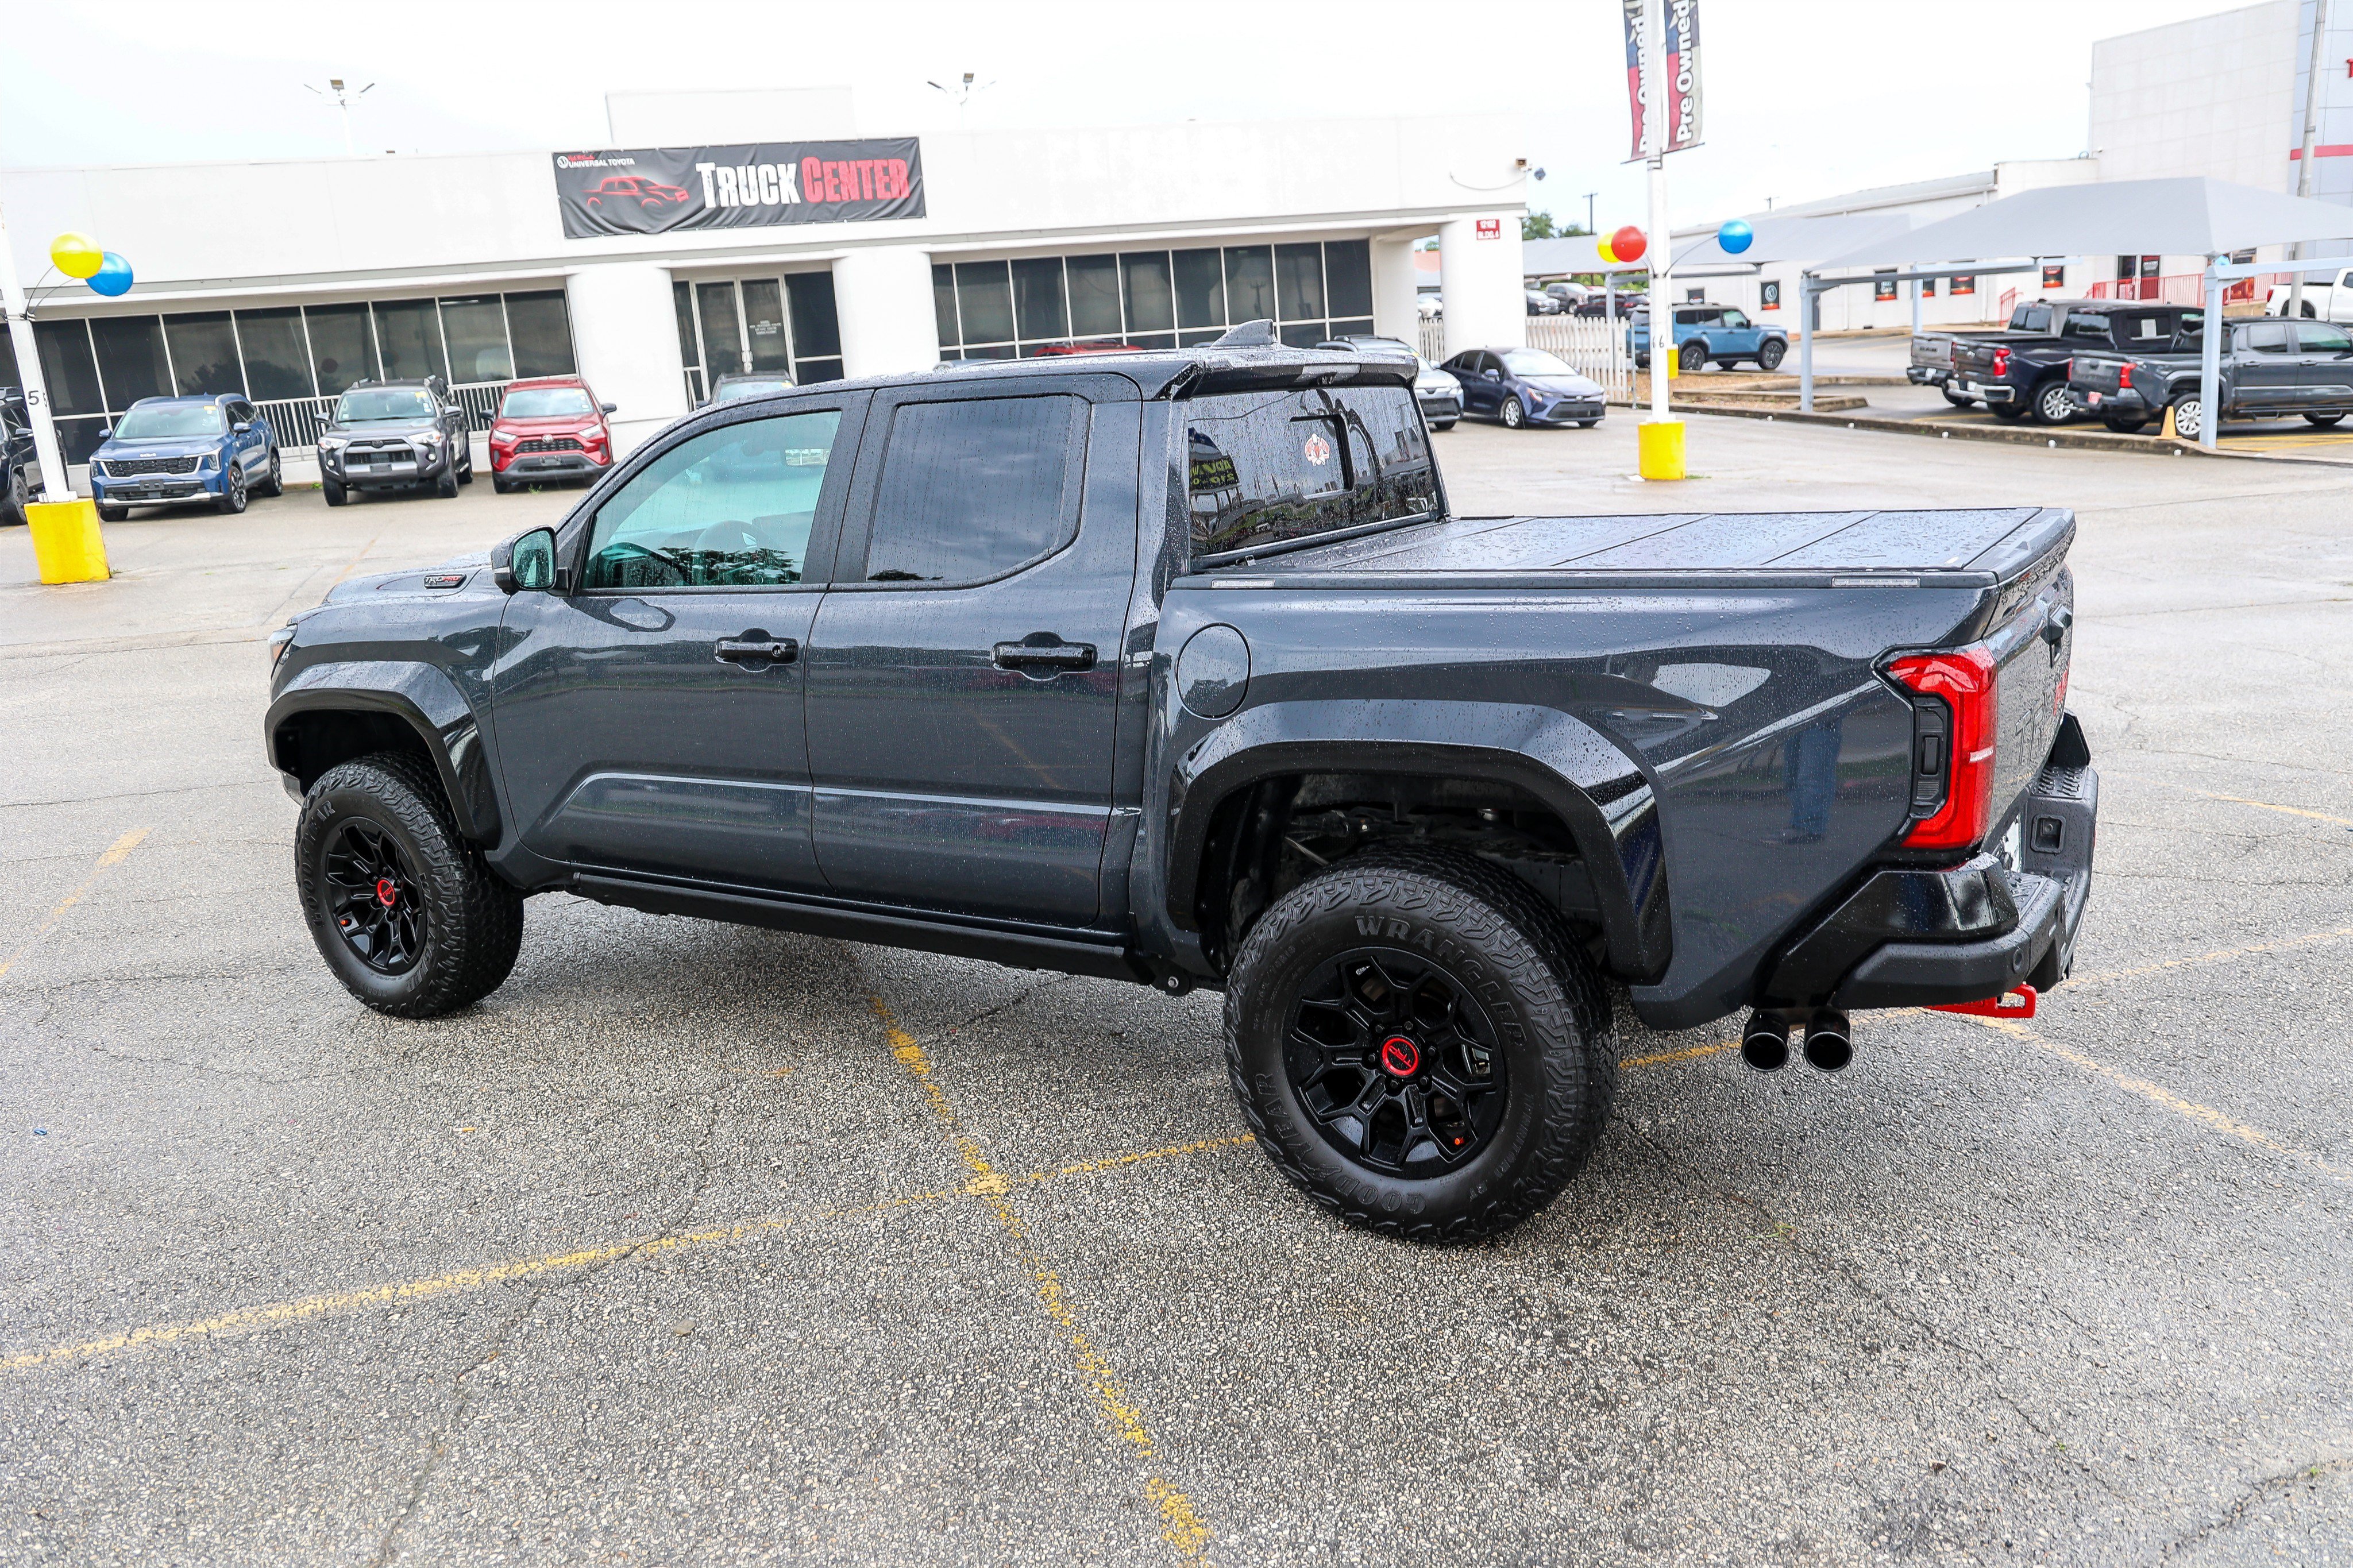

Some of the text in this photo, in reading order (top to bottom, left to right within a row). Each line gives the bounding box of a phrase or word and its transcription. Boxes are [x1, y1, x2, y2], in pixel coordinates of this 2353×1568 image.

[1672, 1, 1694, 142] Pre Owned
[568, 157, 636, 169] UNIVERSAL TOYOTA
[28, 390, 40, 405] 5
[1354, 915, 1527, 1052] WRANGLER
